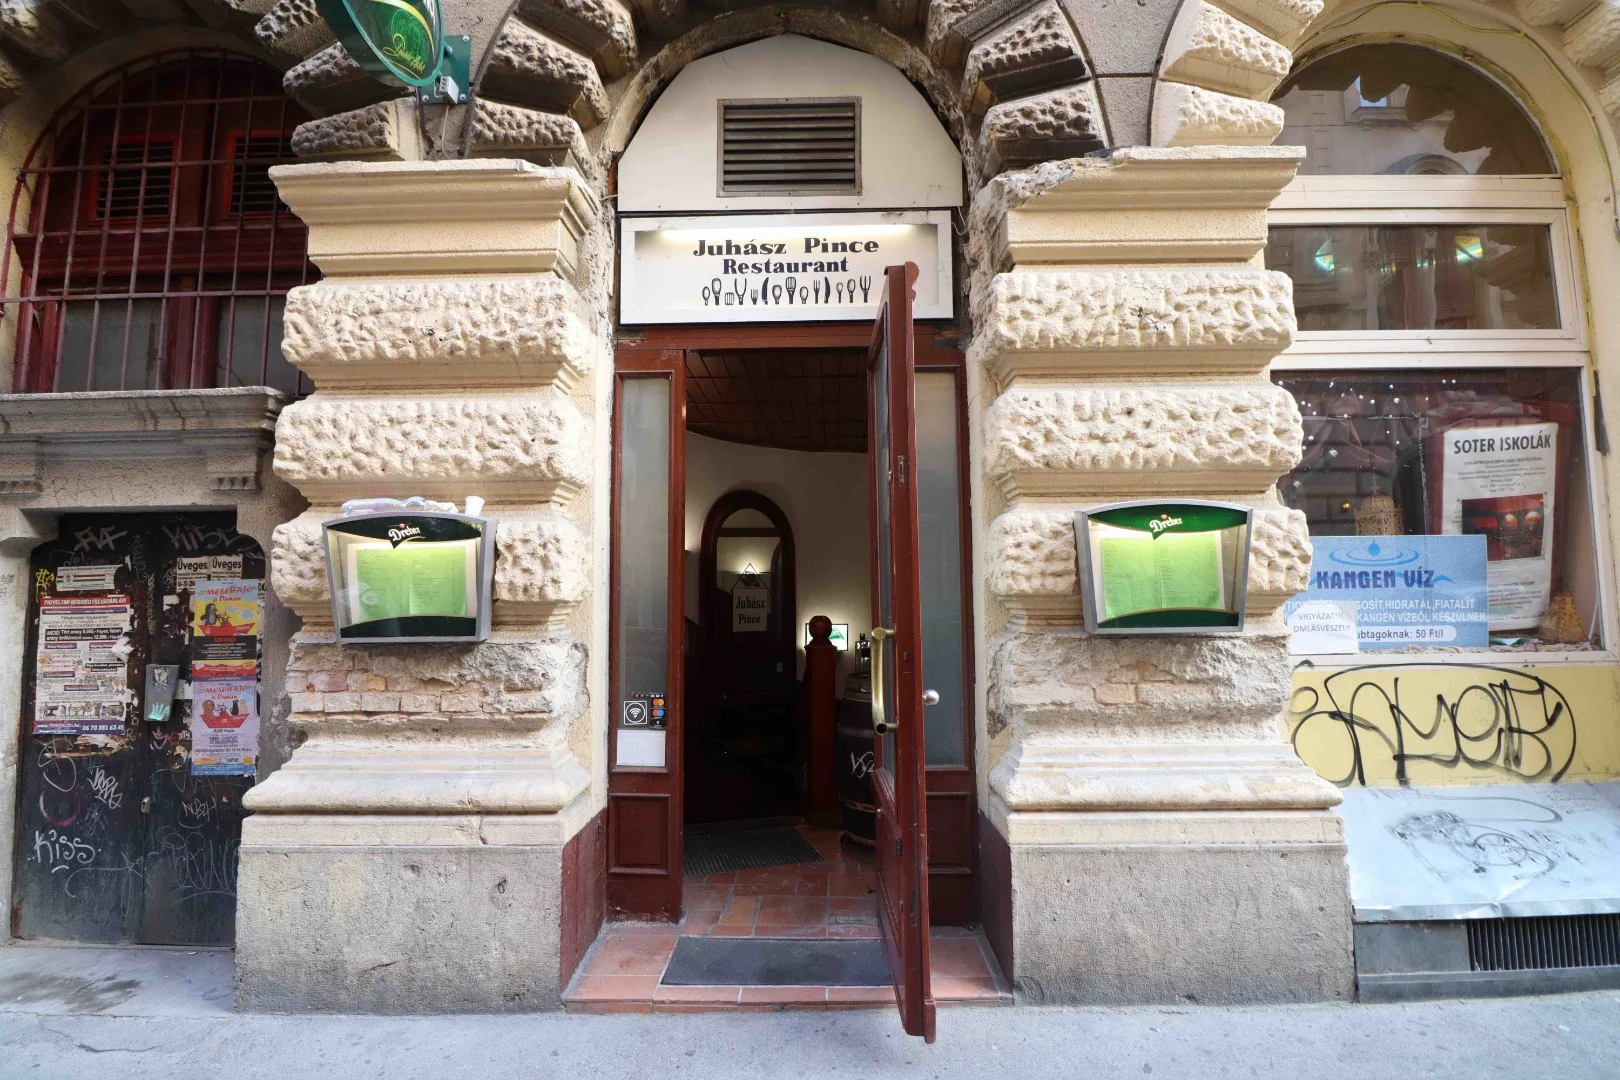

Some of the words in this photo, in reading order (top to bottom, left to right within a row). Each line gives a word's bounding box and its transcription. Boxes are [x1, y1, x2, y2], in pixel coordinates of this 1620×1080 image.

[693, 239, 787, 257] Juhász
[804, 237, 879, 254] Pince
[722, 256, 850, 275] Restaurant
[1454, 438, 1495, 455] SOTER
[1500, 430, 1551, 451] ISKOLÁK
[1149, 516, 1183, 533] Dreher
[388, 525, 421, 542] Dreher
[178, 559, 208, 572] Üveges
[212, 557, 242, 571] Üveges
[1316, 570, 1396, 589] KANGEN
[1404, 566, 1435, 588] VÍZ
[738, 613, 761, 624] Pince
[1356, 612, 1395, 623] KANGEN
[1415, 629, 1427, 639] 50
